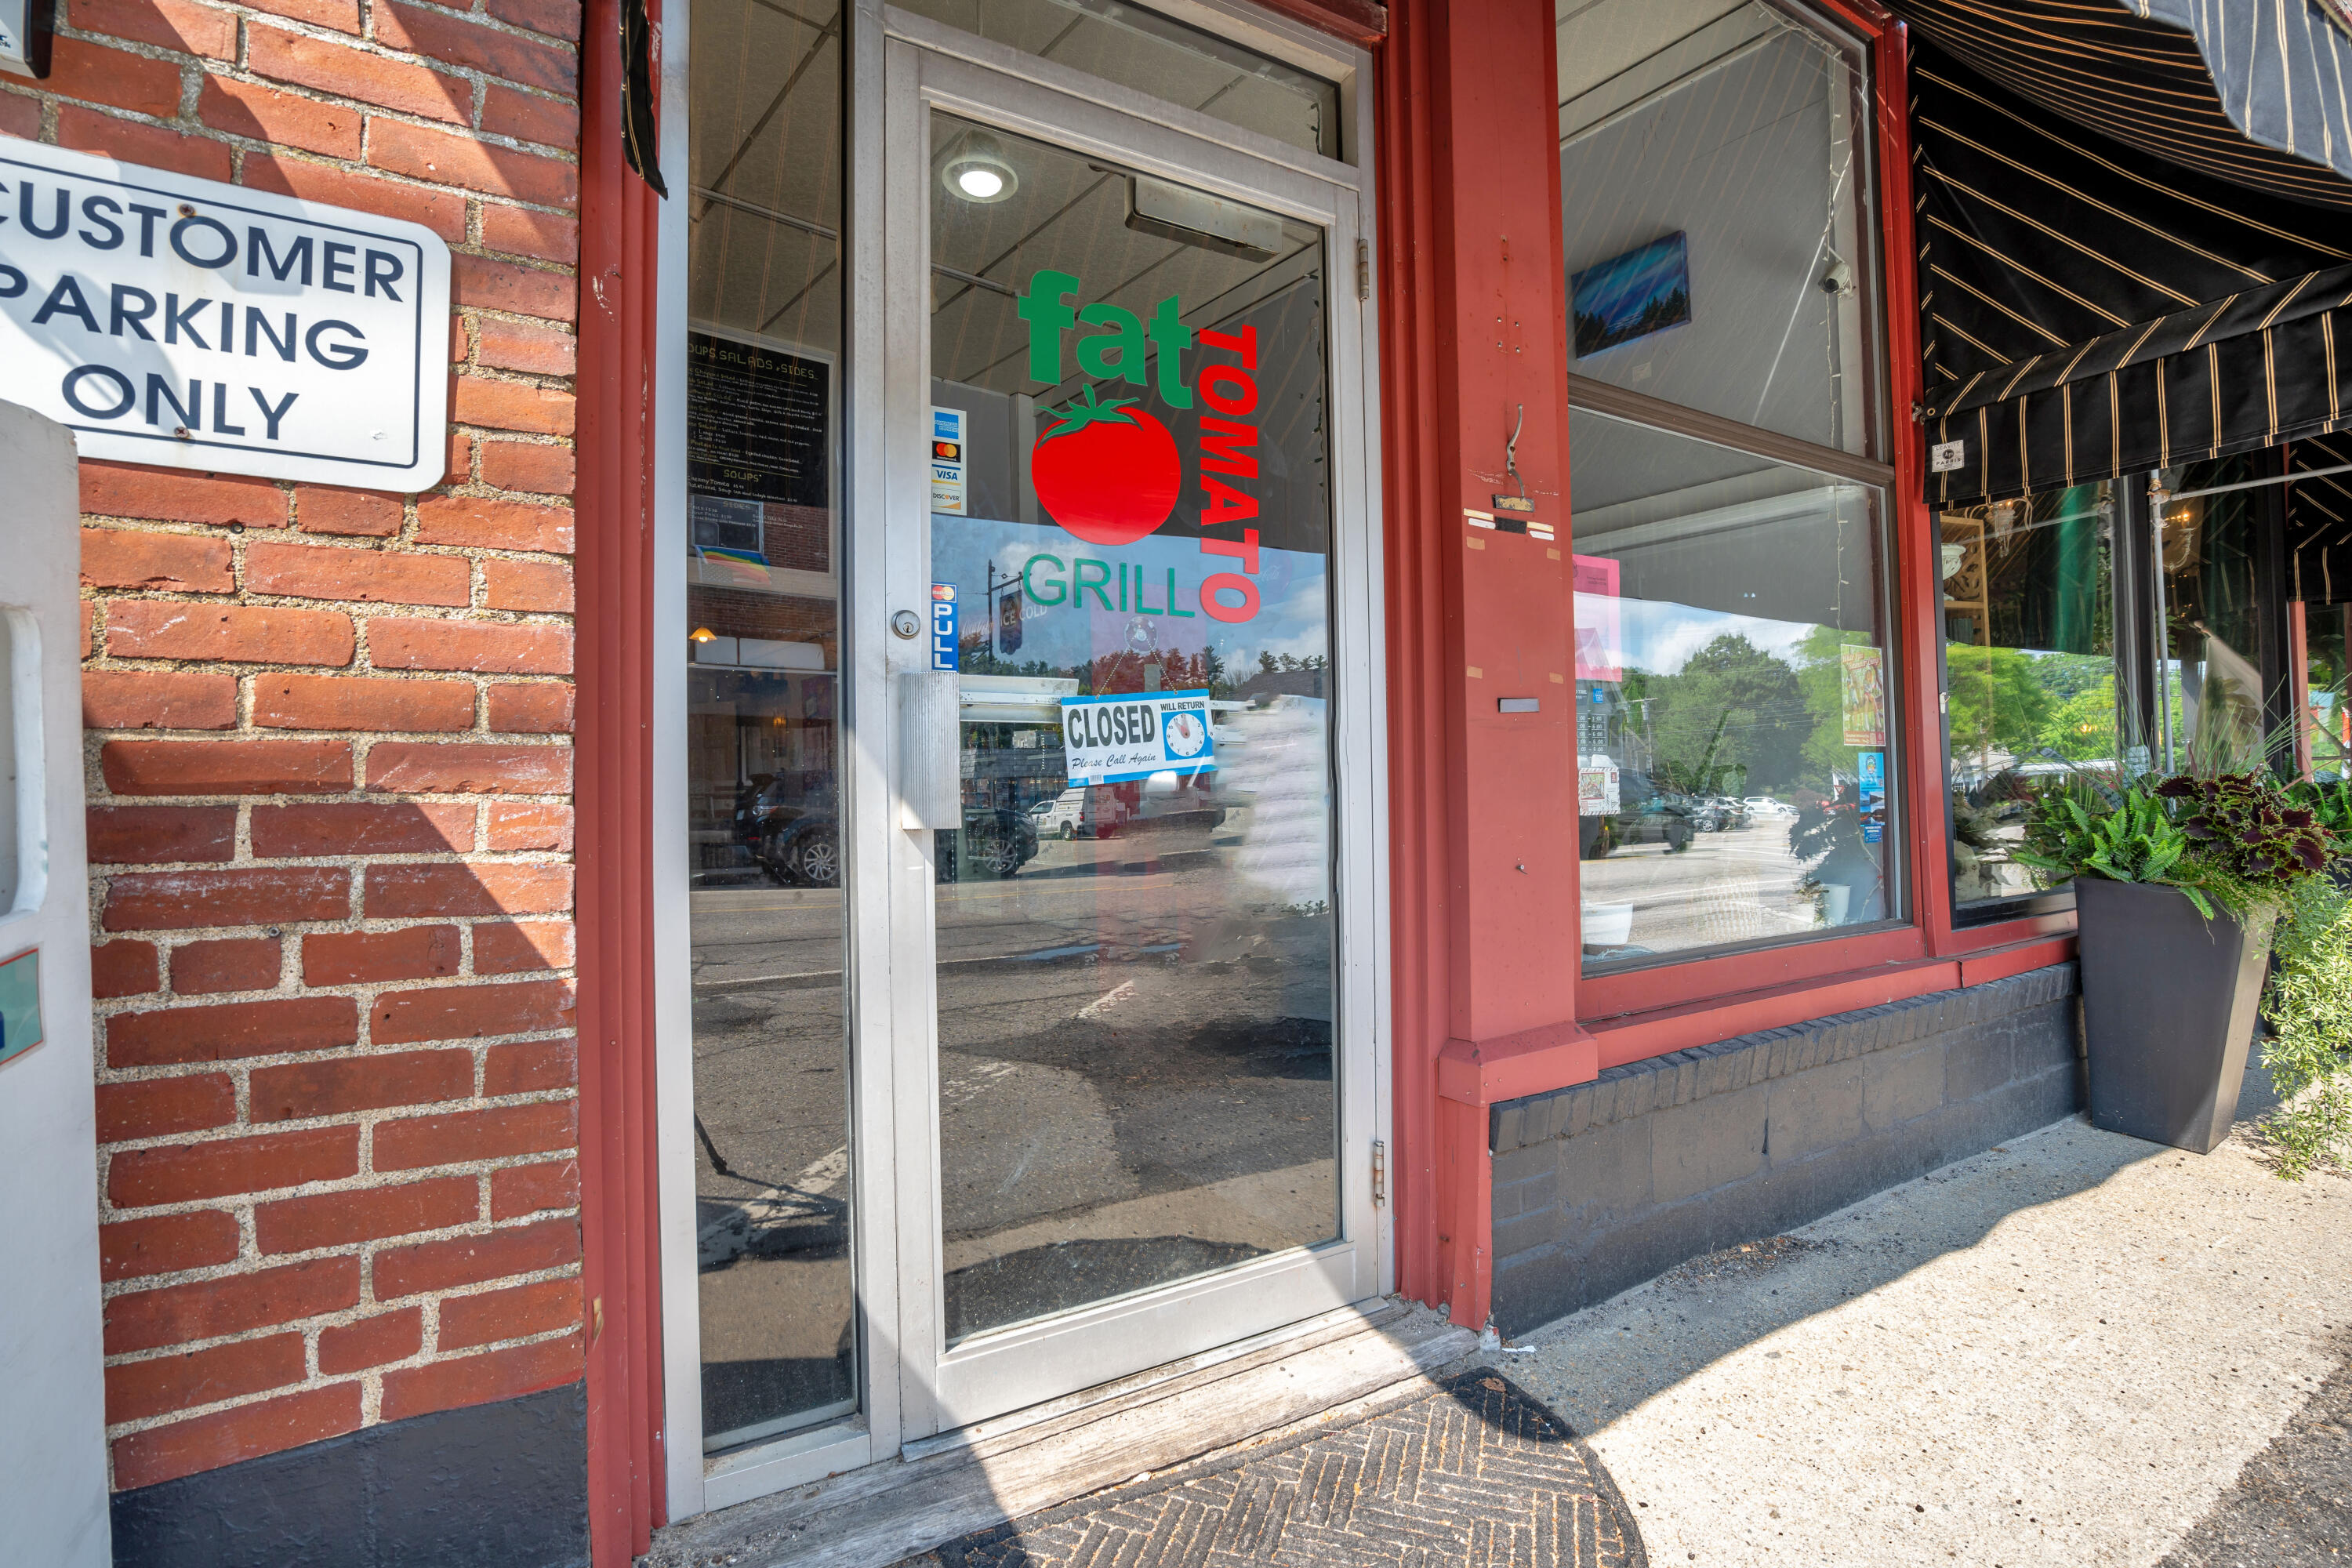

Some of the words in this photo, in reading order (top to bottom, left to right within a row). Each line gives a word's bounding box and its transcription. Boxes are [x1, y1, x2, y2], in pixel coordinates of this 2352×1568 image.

[0, 180, 404, 303] USTOMER
[1018, 269, 1193, 409] fat
[719, 350, 773, 370] SALADS
[62, 364, 299, 441] ONLY
[723, 469, 759, 482] SOUPS
[935, 470, 958, 481] VISA
[1199, 324, 1260, 624] TOMATO
[932, 492, 960, 502] DISCOVER
[1022, 553, 1196, 618] GRILL
[1019, 604, 1047, 621] COLD
[934, 603, 953, 669] PULL
[1160, 702, 1178, 711] WILL
[1178, 700, 1205, 710] RETURN
[1068, 705, 1156, 750] CLOSED
[1072, 757, 1102, 769] Please
[1106, 754, 1127, 768] Call
[1129, 752, 1156, 766] Again
